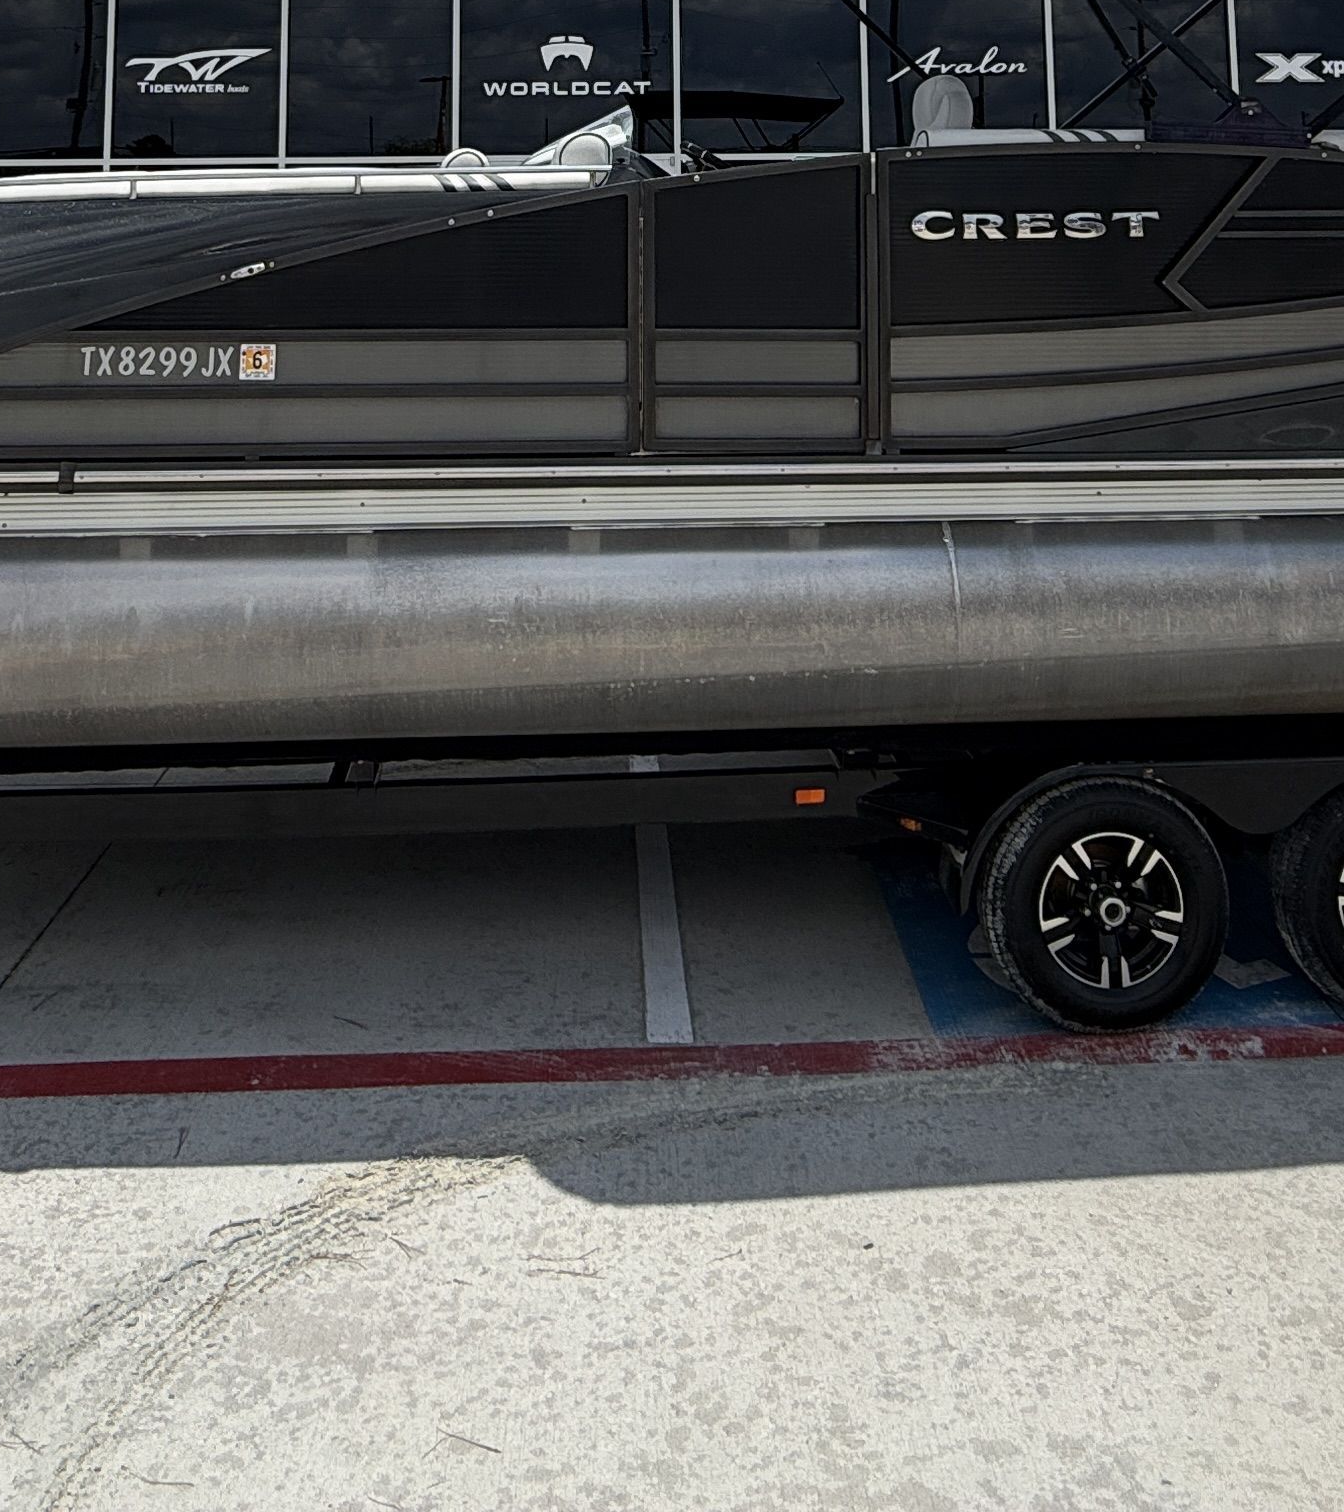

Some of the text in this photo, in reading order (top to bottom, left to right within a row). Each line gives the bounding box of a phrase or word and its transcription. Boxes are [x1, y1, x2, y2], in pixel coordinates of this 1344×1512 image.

[886, 45, 1028, 83] Avalon
[137, 82, 225, 93] TIDEWATER
[483, 81, 651, 96] WORLDCAT
[911, 210, 1160, 240] CREST
[81, 346, 234, 377] TX8299JX
[252, 350, 263, 370] 6
